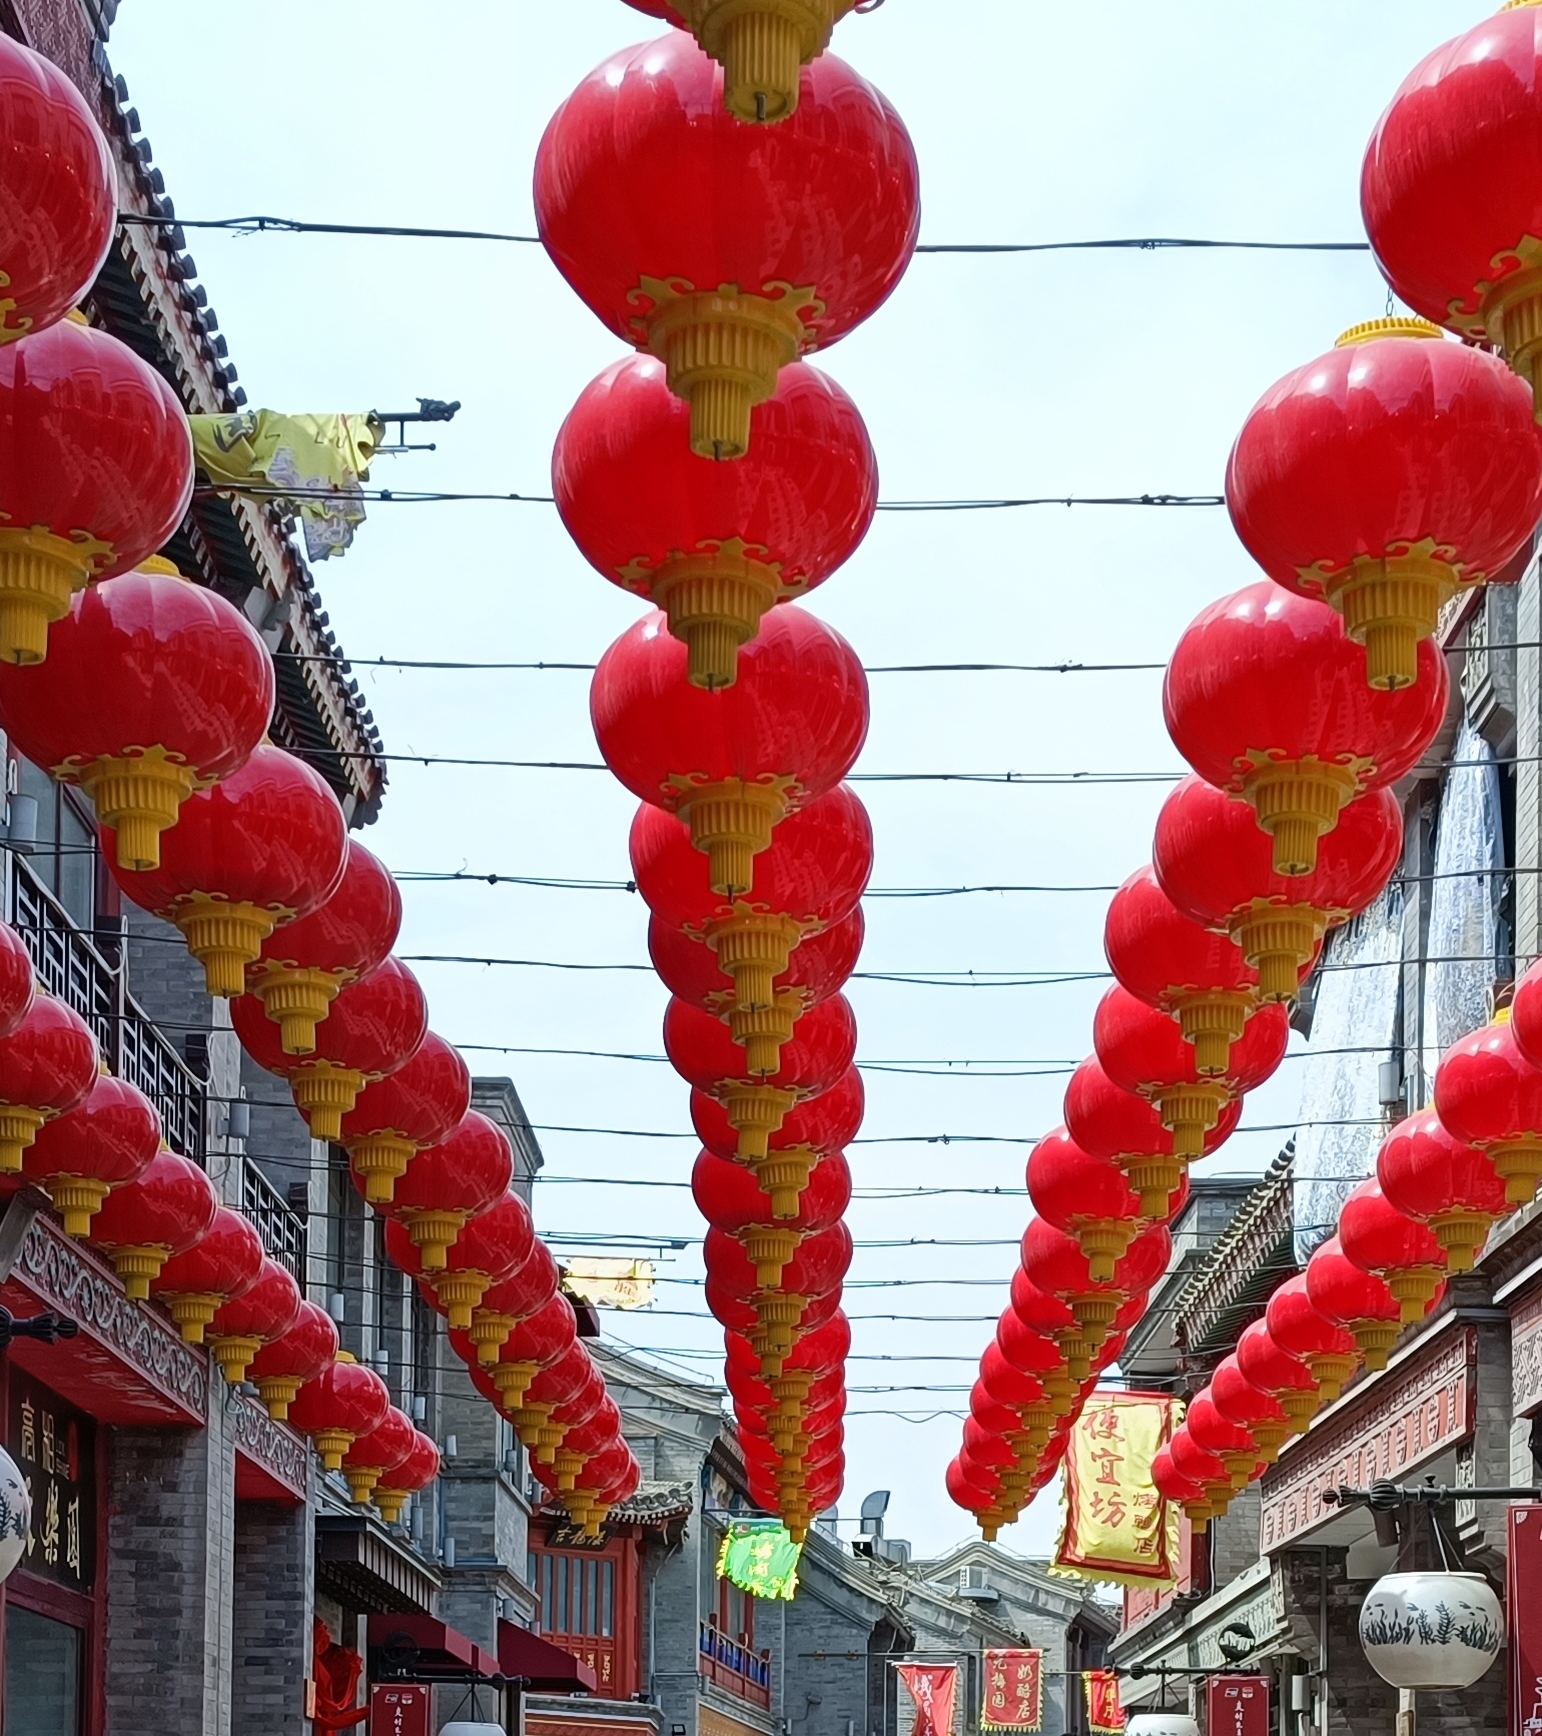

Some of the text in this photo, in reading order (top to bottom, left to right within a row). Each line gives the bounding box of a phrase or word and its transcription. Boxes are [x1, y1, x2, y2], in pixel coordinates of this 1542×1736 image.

[1082, 1409, 1126, 1529] 便宜坊
[1132, 1491, 1158, 1556] 烤鸭店
[1015, 1664, 1033, 1720] 奶酪店
